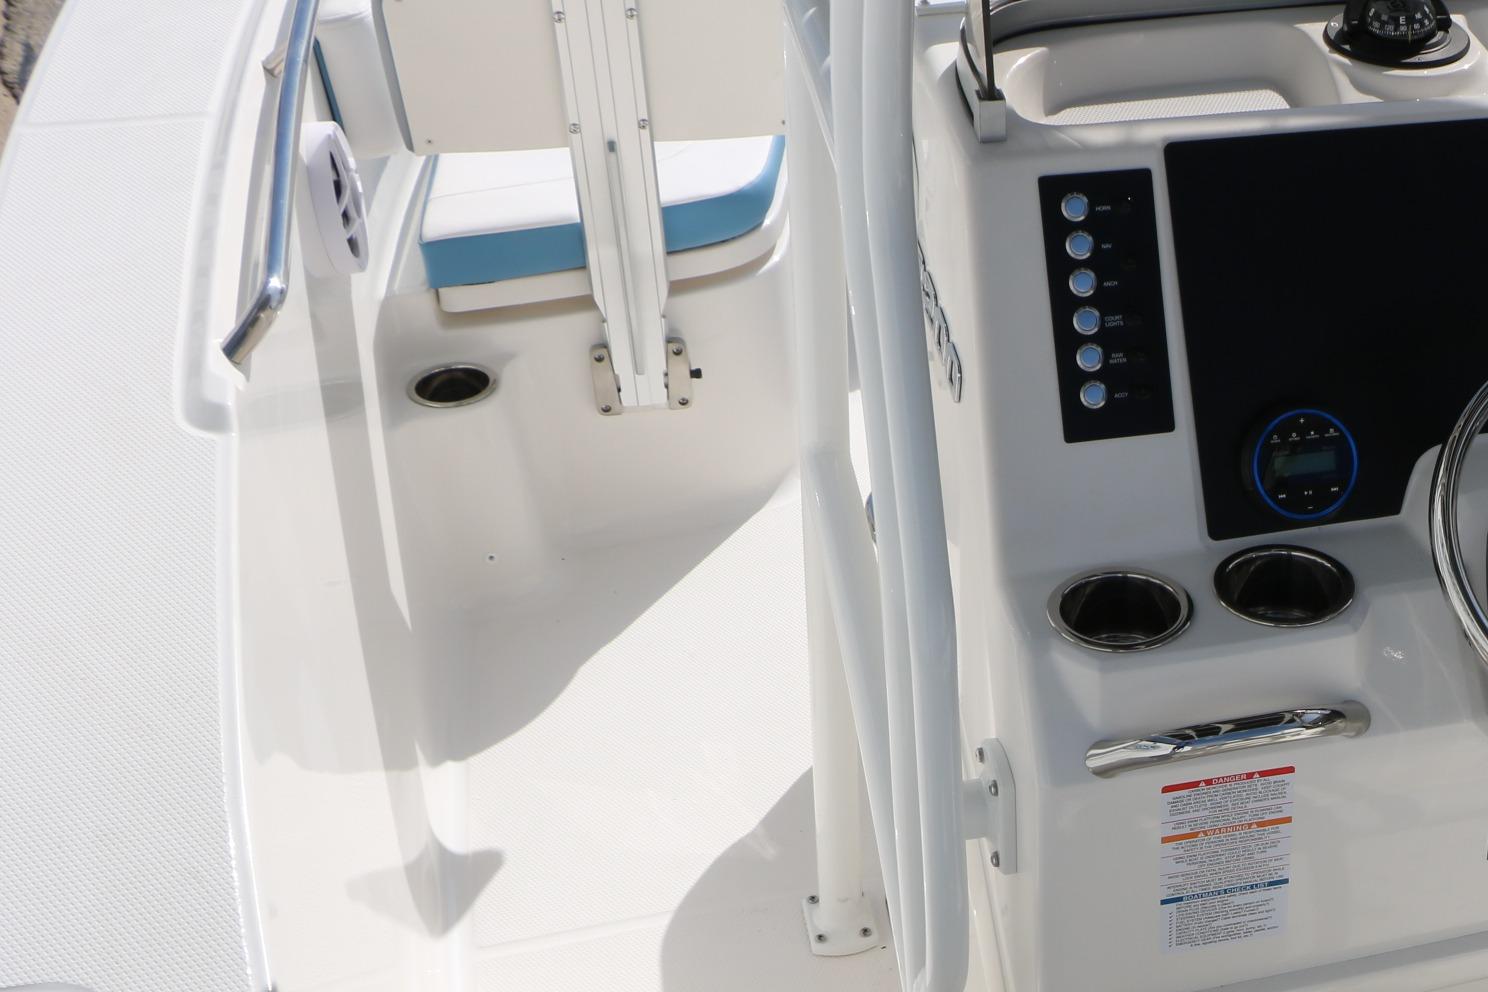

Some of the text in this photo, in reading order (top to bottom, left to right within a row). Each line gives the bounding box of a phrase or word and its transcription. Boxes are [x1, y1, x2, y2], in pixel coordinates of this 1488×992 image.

[1400, 16, 1406, 24] E
[1212, 773, 1247, 785] DANGER
[1206, 824, 1249, 836] WARNING
[1182, 882, 1269, 902] BOATMAN'S CHECK LIST
